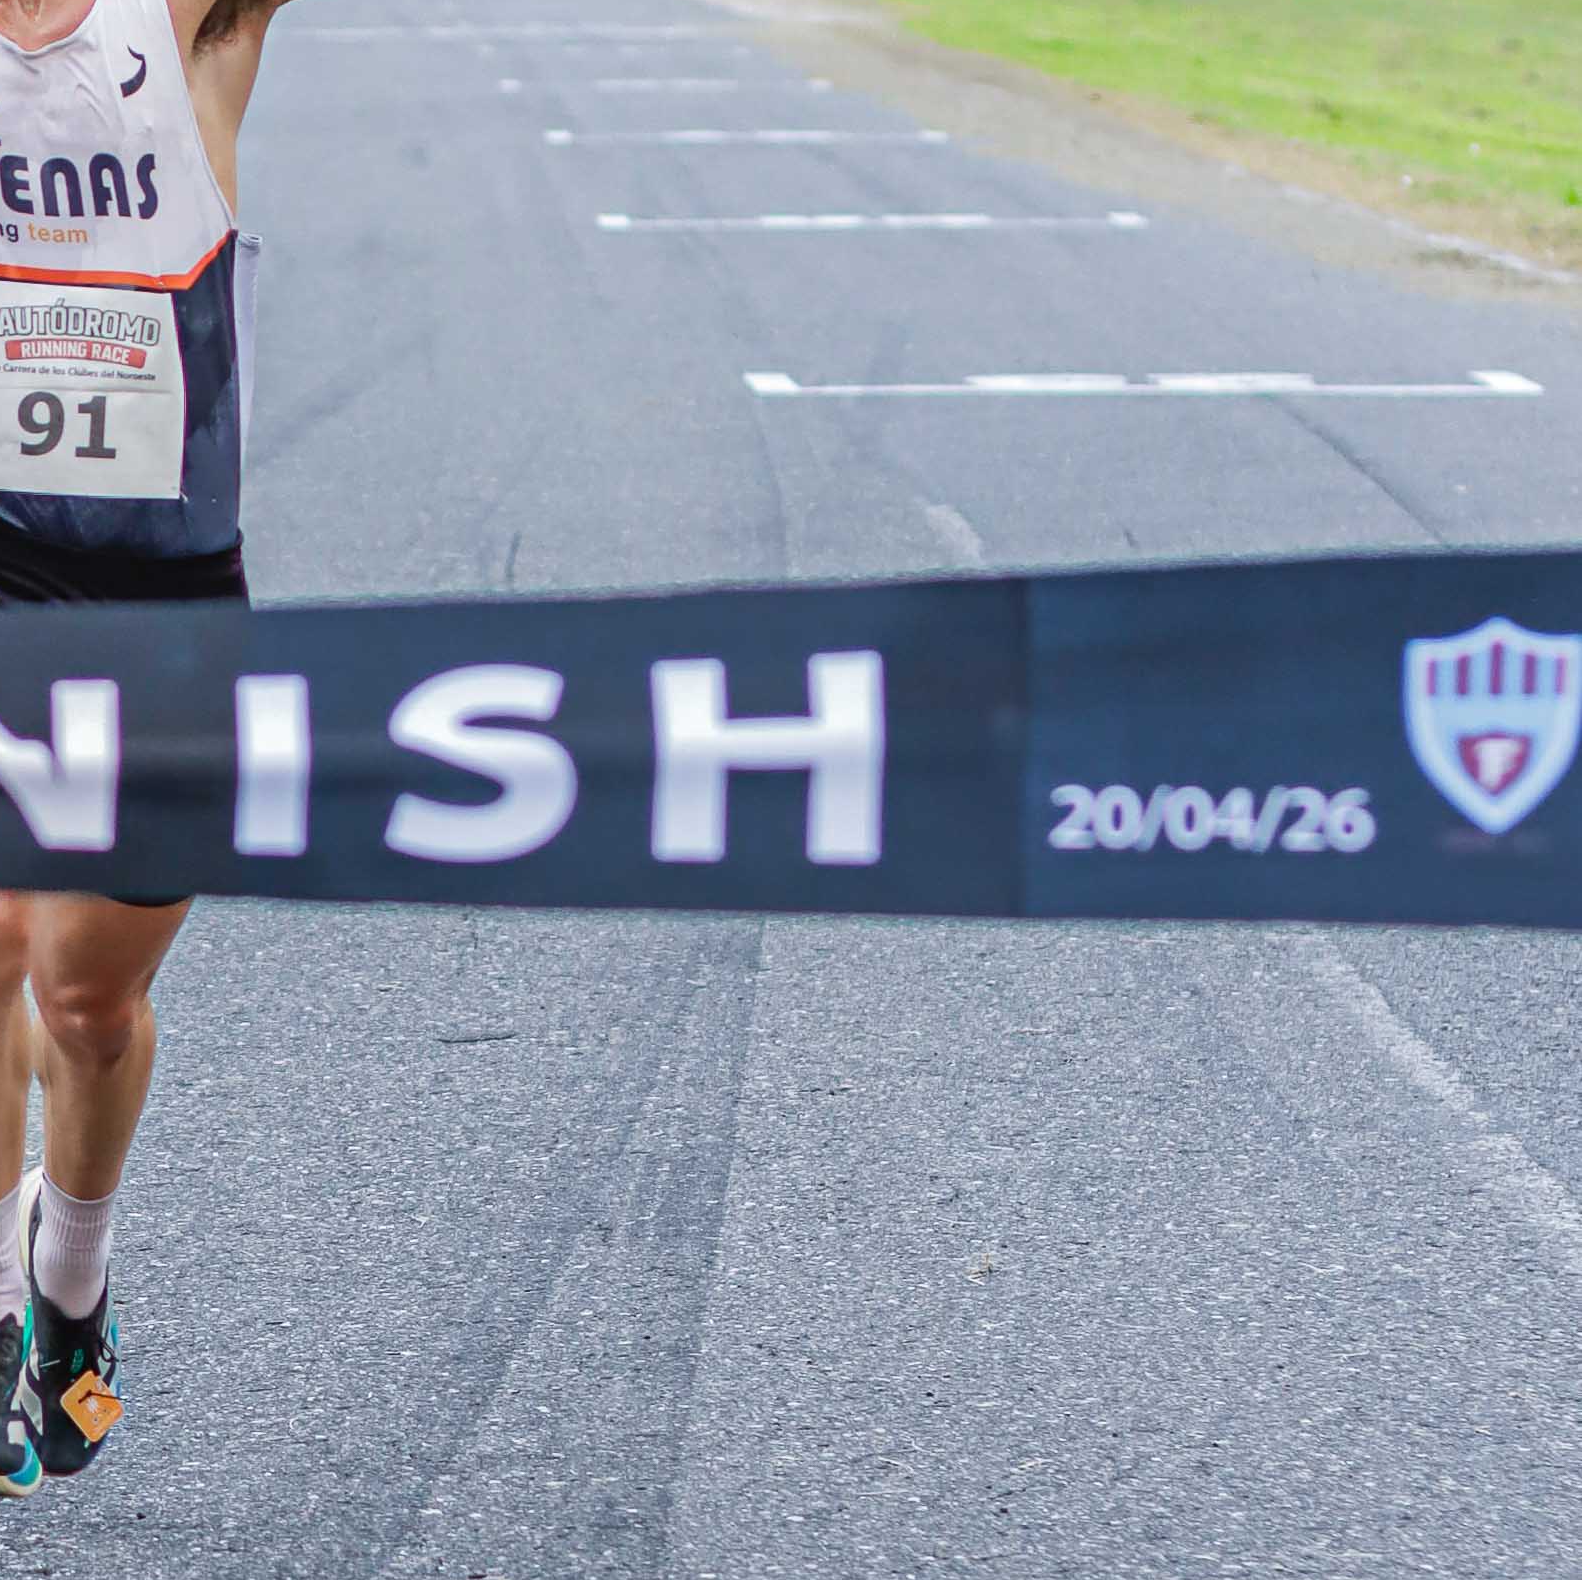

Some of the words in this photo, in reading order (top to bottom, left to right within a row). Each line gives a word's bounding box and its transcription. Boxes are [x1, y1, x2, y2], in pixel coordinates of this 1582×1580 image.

[27, 221, 88, 244] team
[20, 340, 87, 359] RUNNING
[91, 342, 132, 365] RACE
[3, 363, 37, 375] Carrera
[38, 364, 51, 375] de
[101, 368, 115, 380] del
[18, 391, 116, 459] 91
[1047, 783, 1378, 855] 20/04/26
